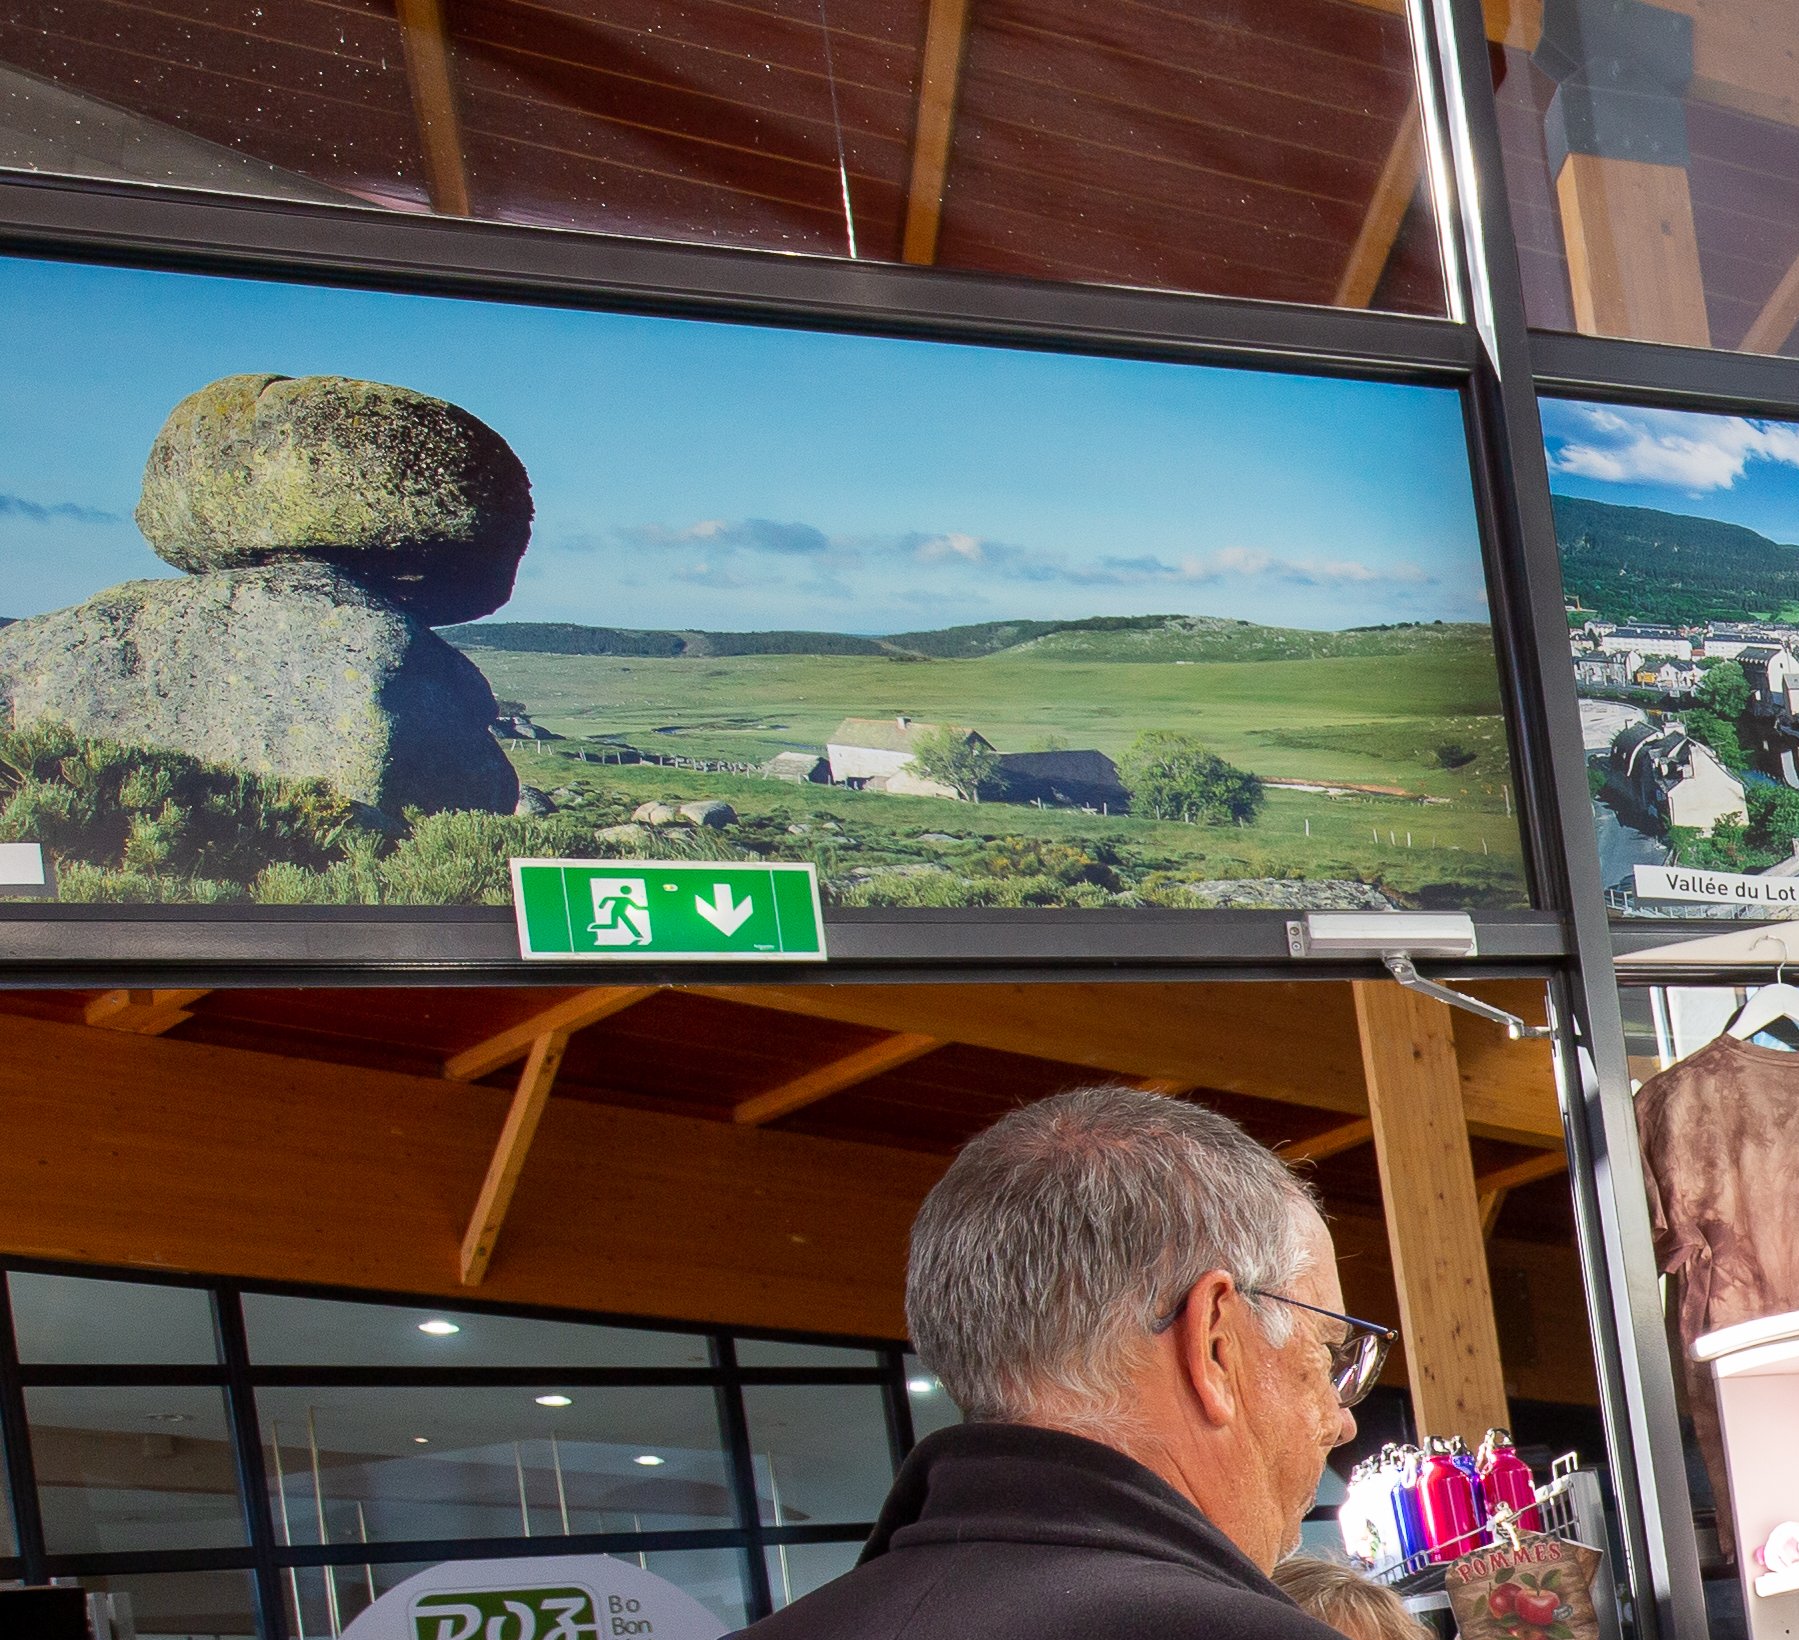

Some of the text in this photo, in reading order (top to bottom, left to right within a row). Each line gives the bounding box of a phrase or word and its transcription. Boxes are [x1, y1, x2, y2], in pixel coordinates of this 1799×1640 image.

[1666, 873, 1729, 896] Vallée
[1736, 882, 1759, 898] du
[1766, 884, 1796, 902] Lot
[1457, 1541, 1562, 1585] POMMES
[608, 1594, 641, 1615] Bo
[612, 1617, 652, 1636] Bon
